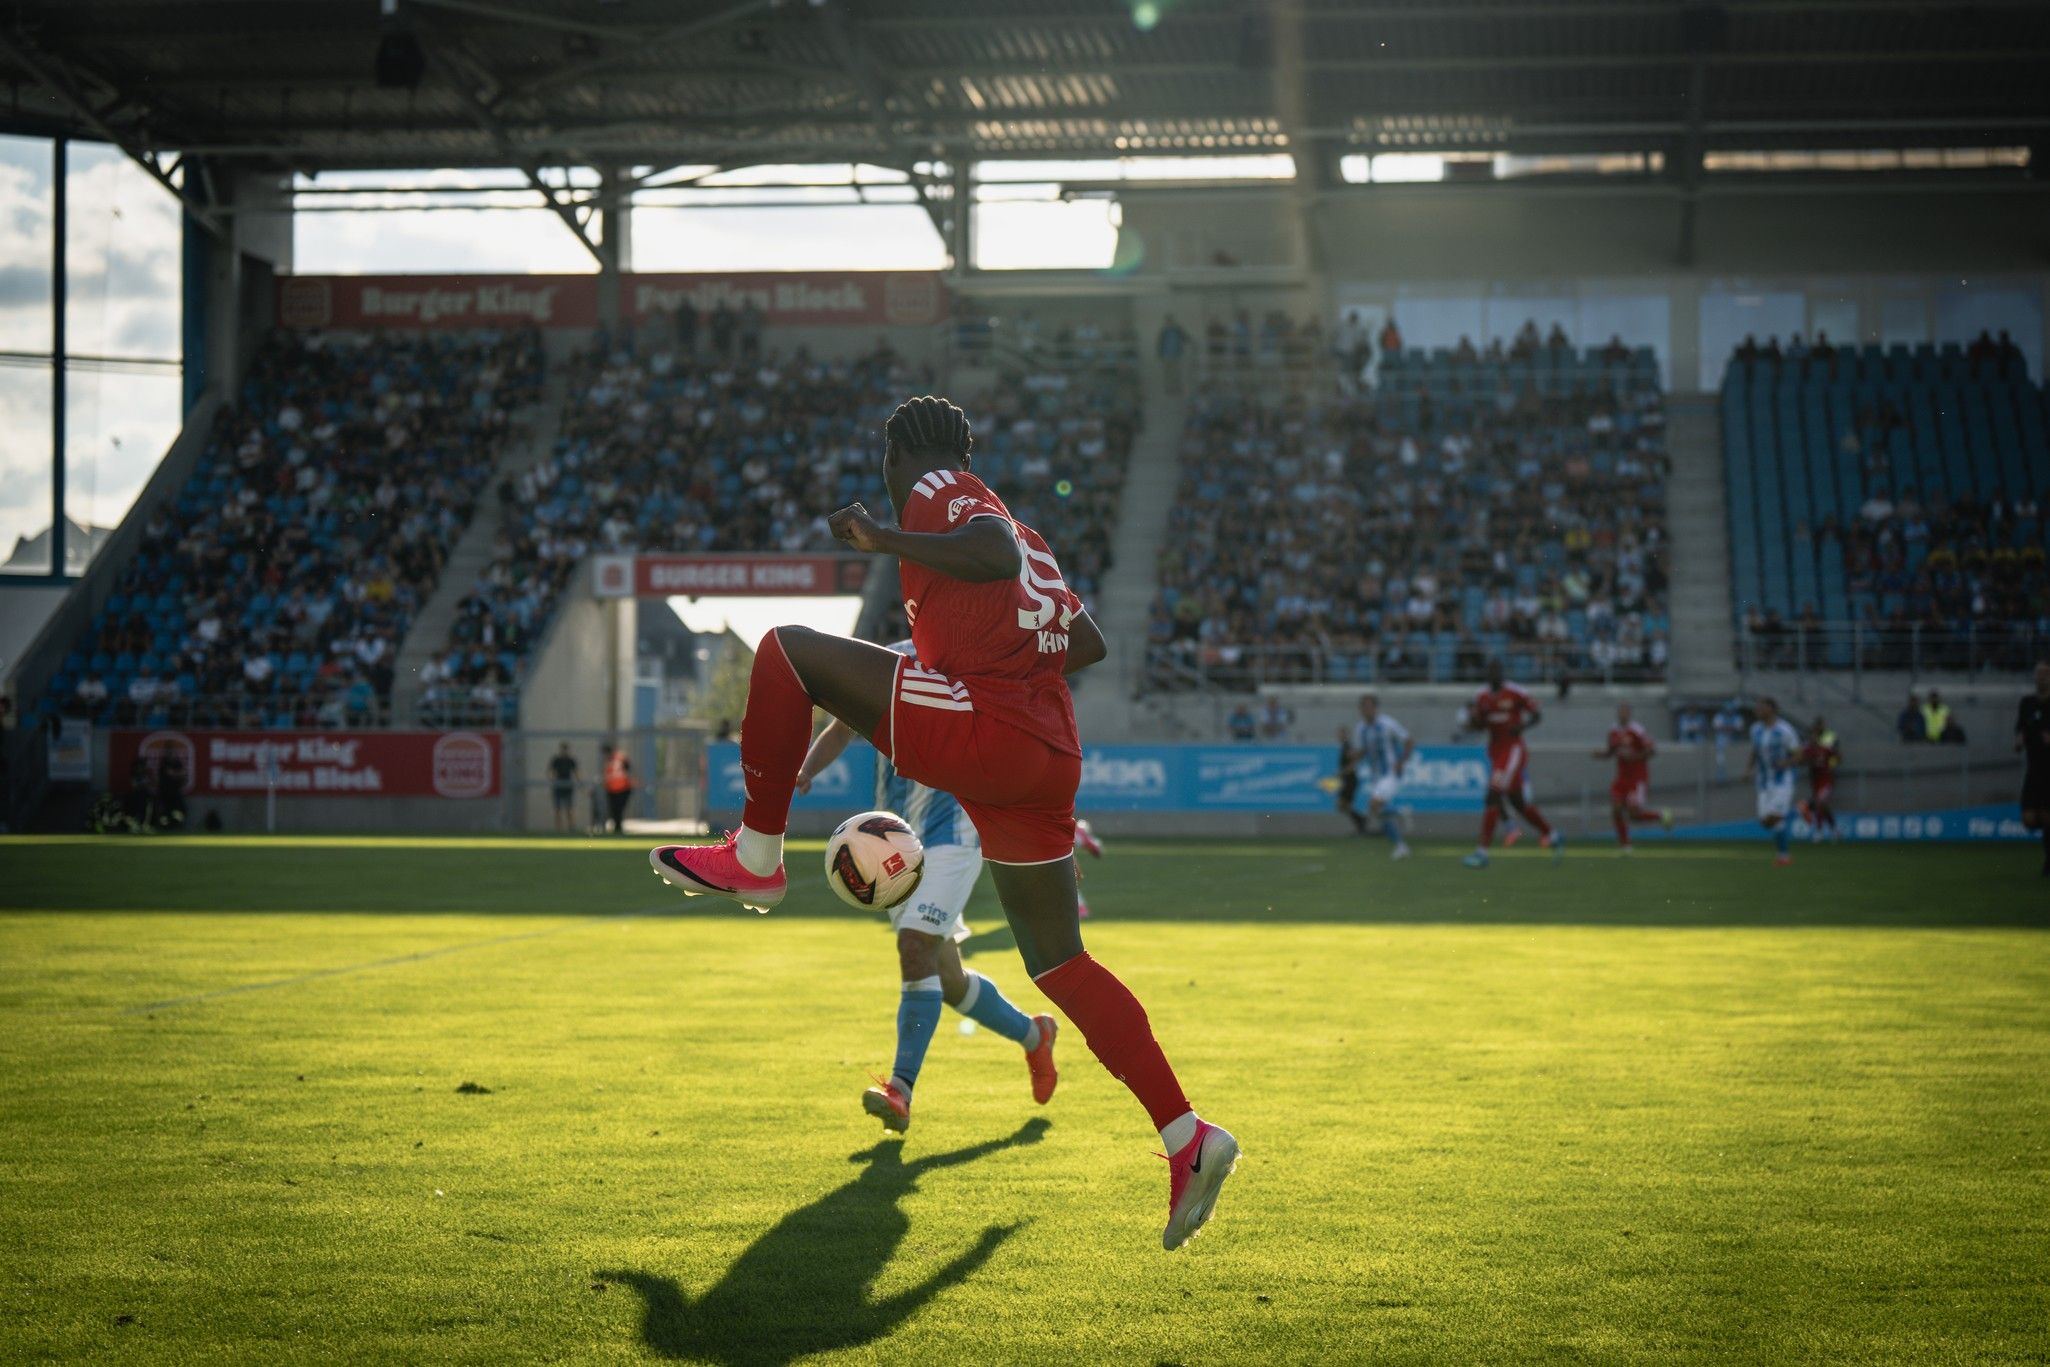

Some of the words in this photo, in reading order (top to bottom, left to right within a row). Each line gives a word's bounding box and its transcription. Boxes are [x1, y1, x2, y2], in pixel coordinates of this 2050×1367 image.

[360, 286, 472, 322] Burger
[476, 285, 555, 322] King
[775, 281, 866, 312] Block
[651, 563, 747, 588] BURGER
[753, 564, 815, 587] KING
[209, 738, 294, 768] Burger
[298, 737, 357, 768] King
[314, 766, 382, 790] Block
[917, 902, 948, 922] eins
[920, 914, 941, 926] JAKO
